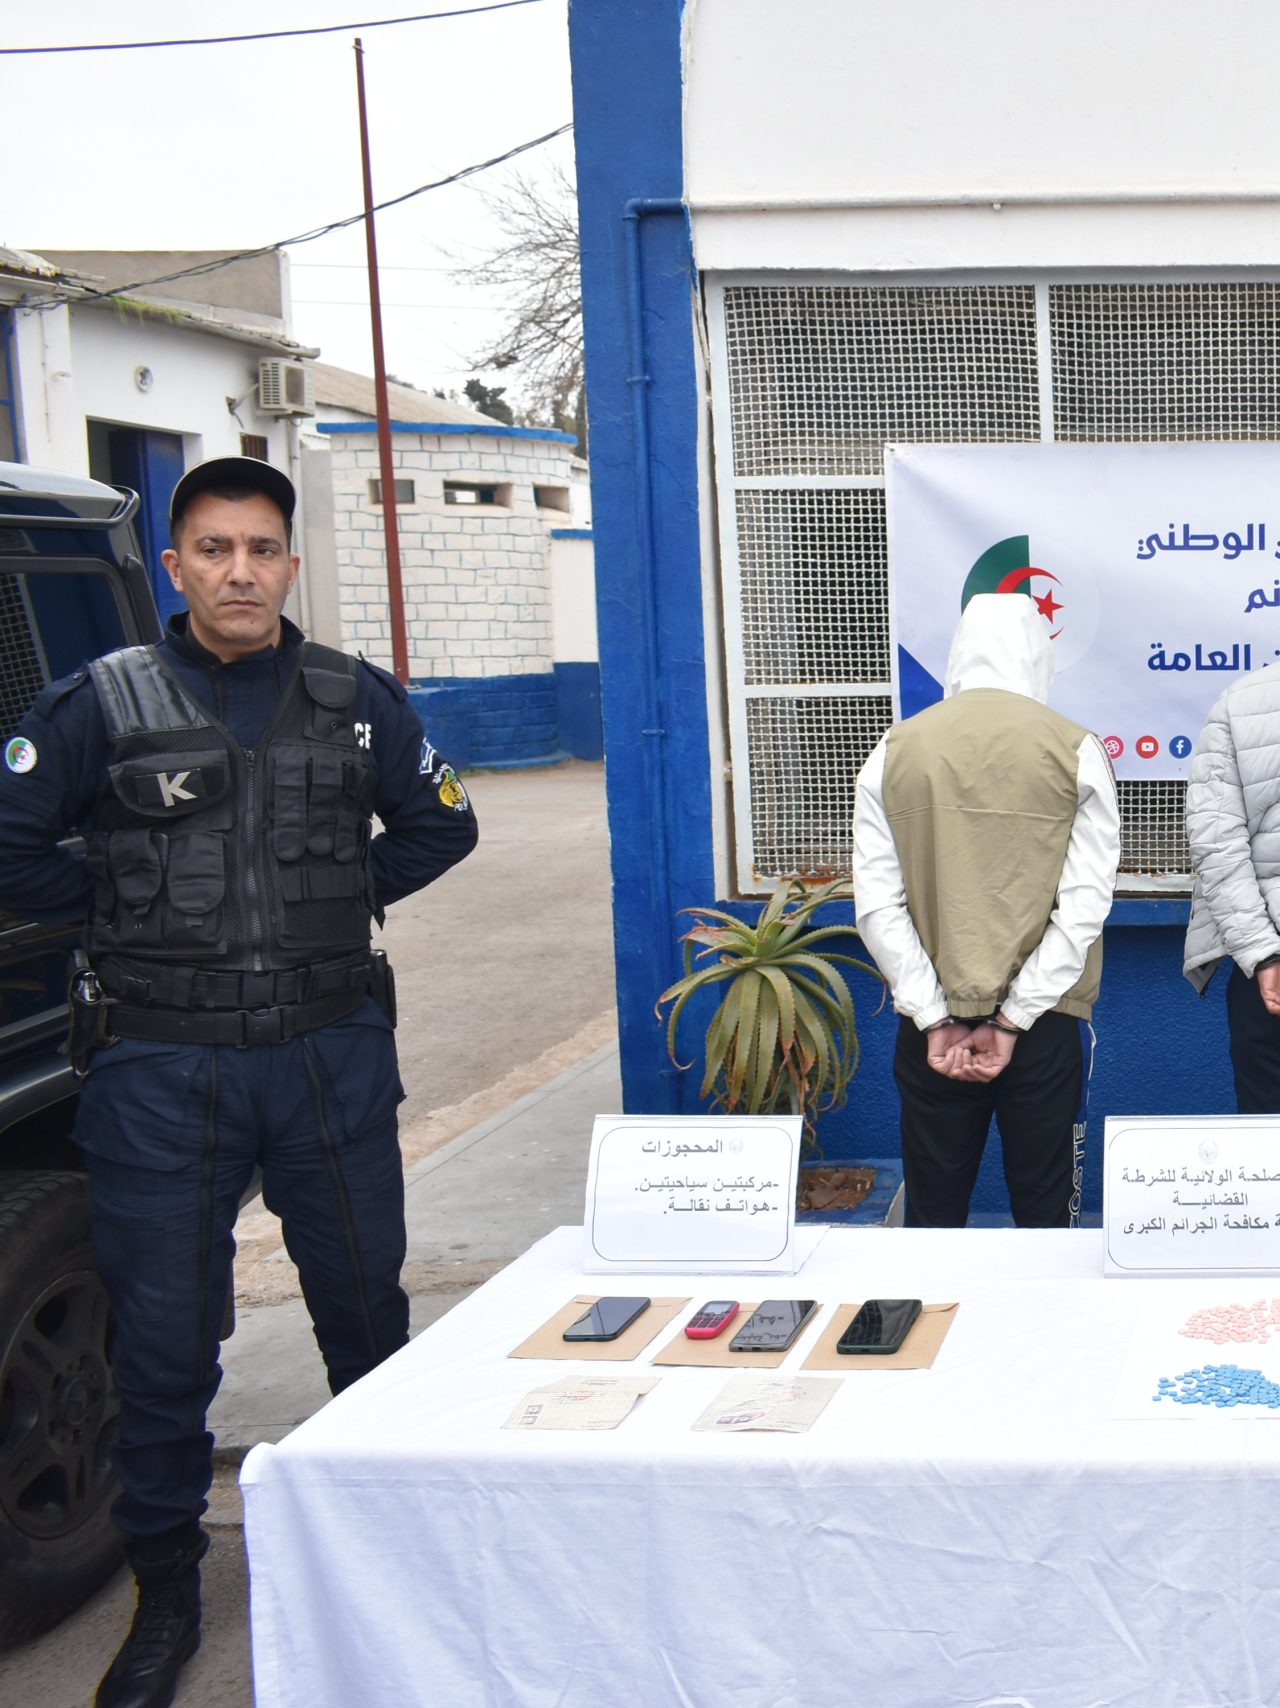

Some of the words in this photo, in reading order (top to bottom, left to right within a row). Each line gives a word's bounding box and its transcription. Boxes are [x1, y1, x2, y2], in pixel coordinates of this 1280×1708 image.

[1136, 522, 1266, 560] الوطني
[1147, 642, 1251, 672] العامة
[642, 1140, 723, 1157] المحجوزات
[1122, 1167, 1176, 1186] للشرطة
[1181, 1167, 1232, 1186] الولائية
[1123, 1217, 1166, 1234] الكبرى
[1171, 1216, 1217, 1236] الجرائم
[1223, 1214, 1269, 1229] مكافحة
